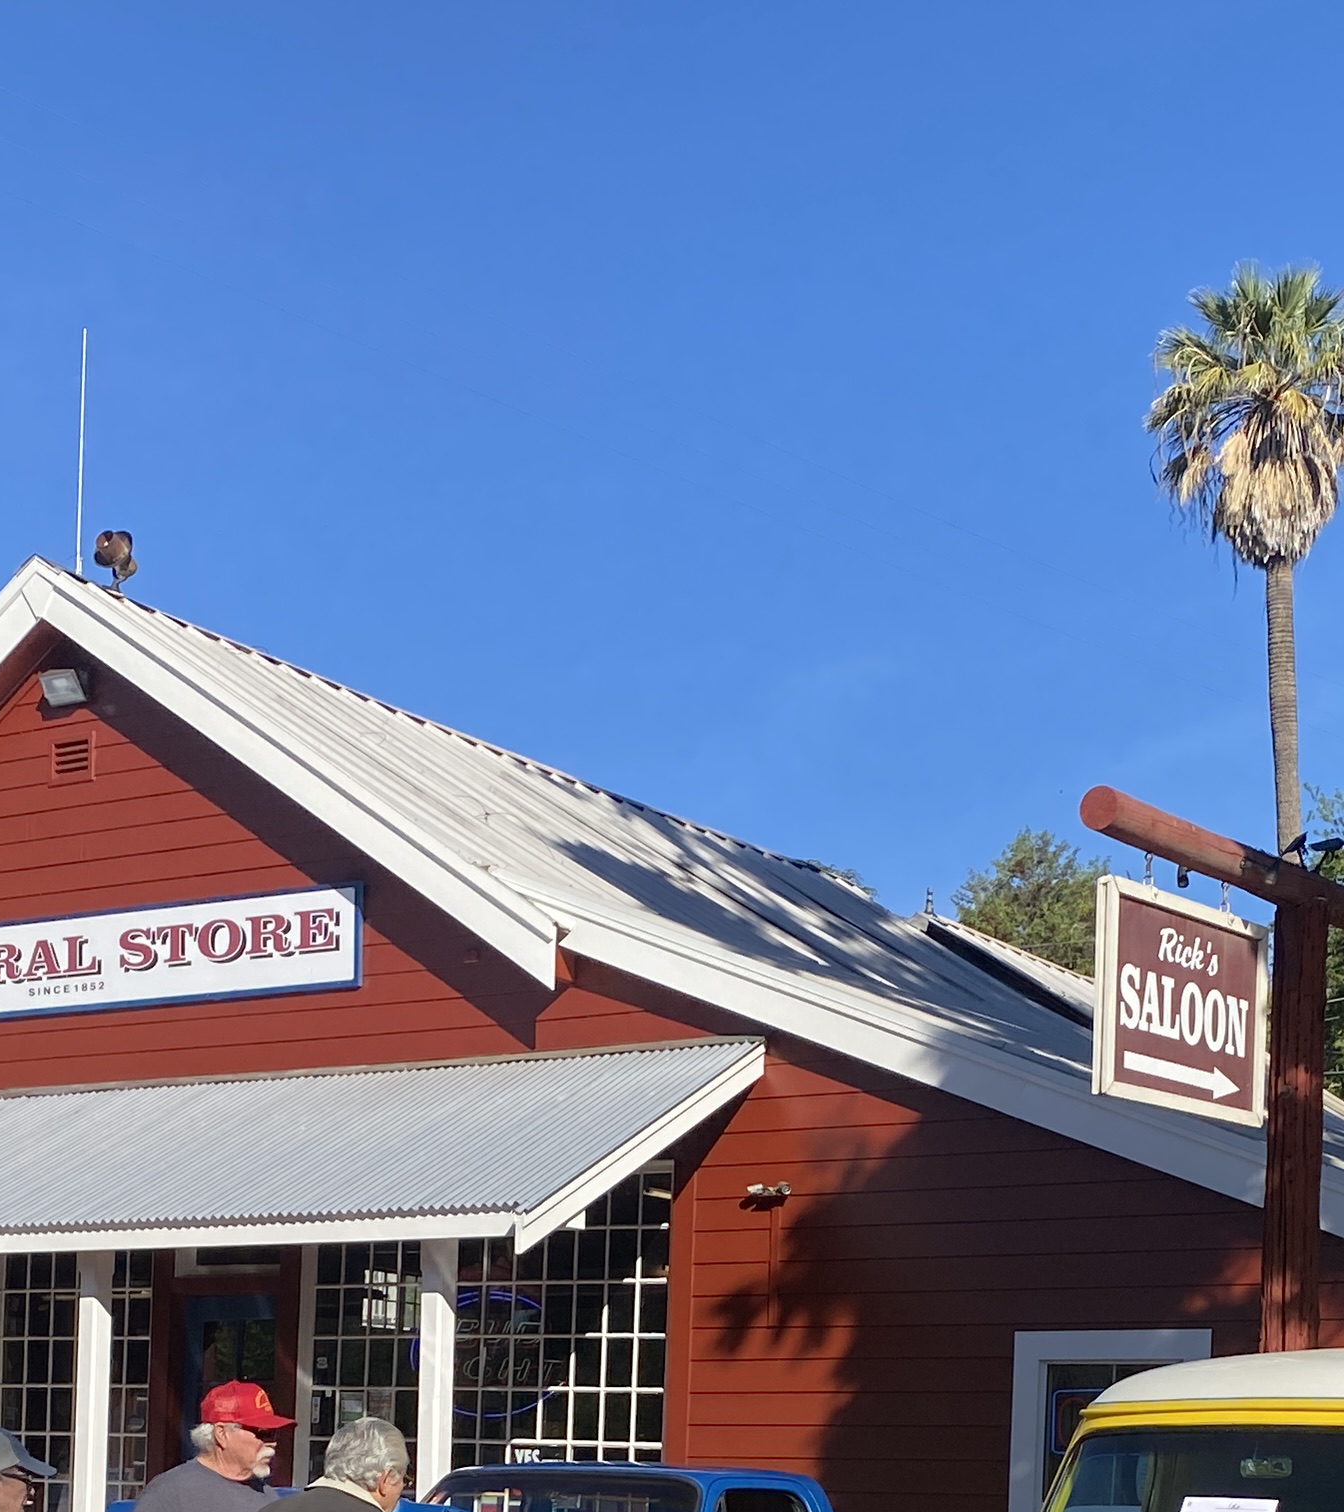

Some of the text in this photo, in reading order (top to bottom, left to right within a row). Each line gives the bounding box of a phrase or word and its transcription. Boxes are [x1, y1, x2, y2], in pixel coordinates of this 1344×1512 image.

[119, 907, 341, 974] STORE
[1158, 927, 1219, 977] Rick's
[28, 981, 105, 997] SINCE 1852
[1119, 963, 1249, 1059] SALOON
